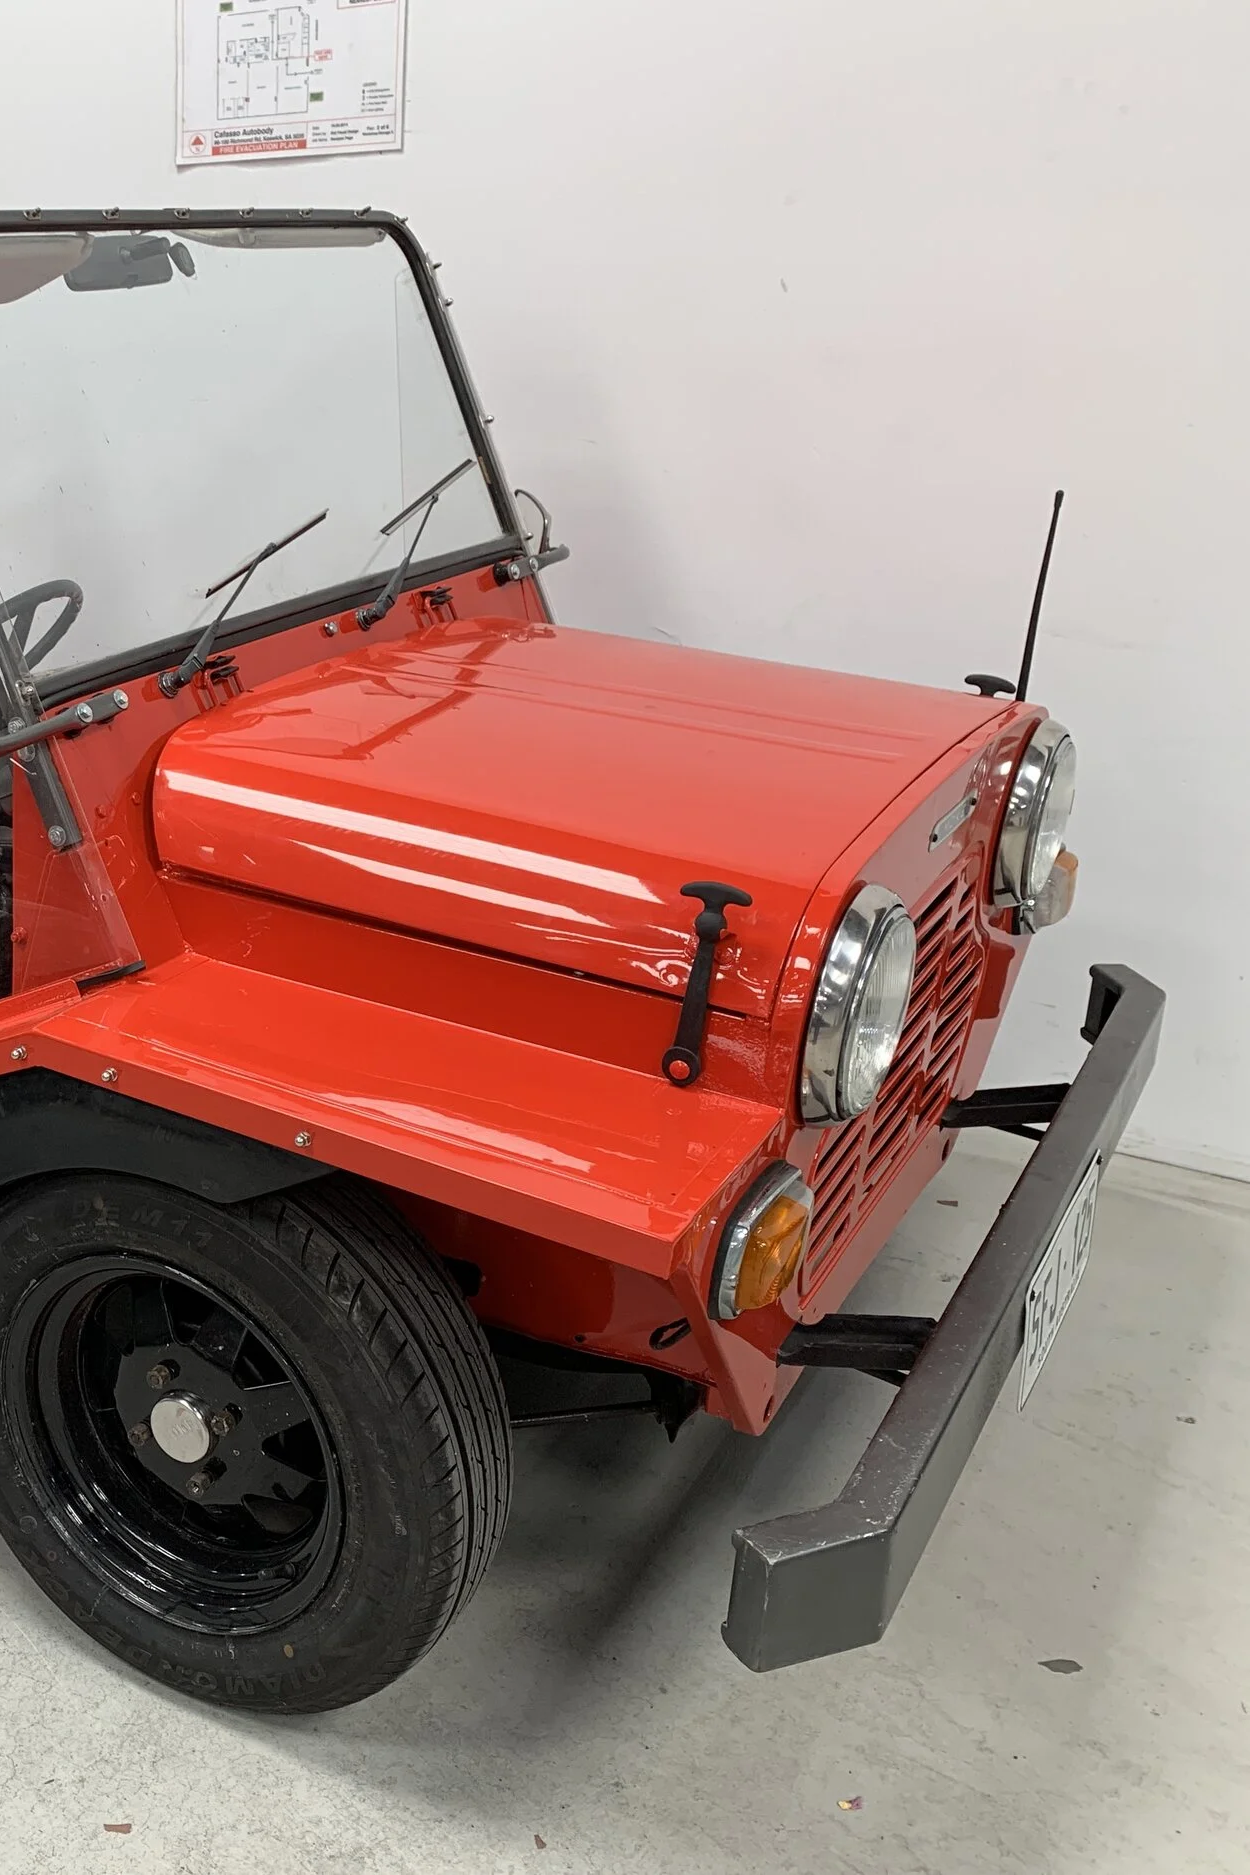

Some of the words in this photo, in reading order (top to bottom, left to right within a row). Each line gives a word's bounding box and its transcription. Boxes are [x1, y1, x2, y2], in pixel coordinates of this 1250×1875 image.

[213, 130, 241, 139] Cafasso
[242, 126, 274, 136] Autobody
[219, 145, 234, 154] FIRE
[235, 142, 279, 153] EVACUATION
[279, 141, 299, 150] PLAN
